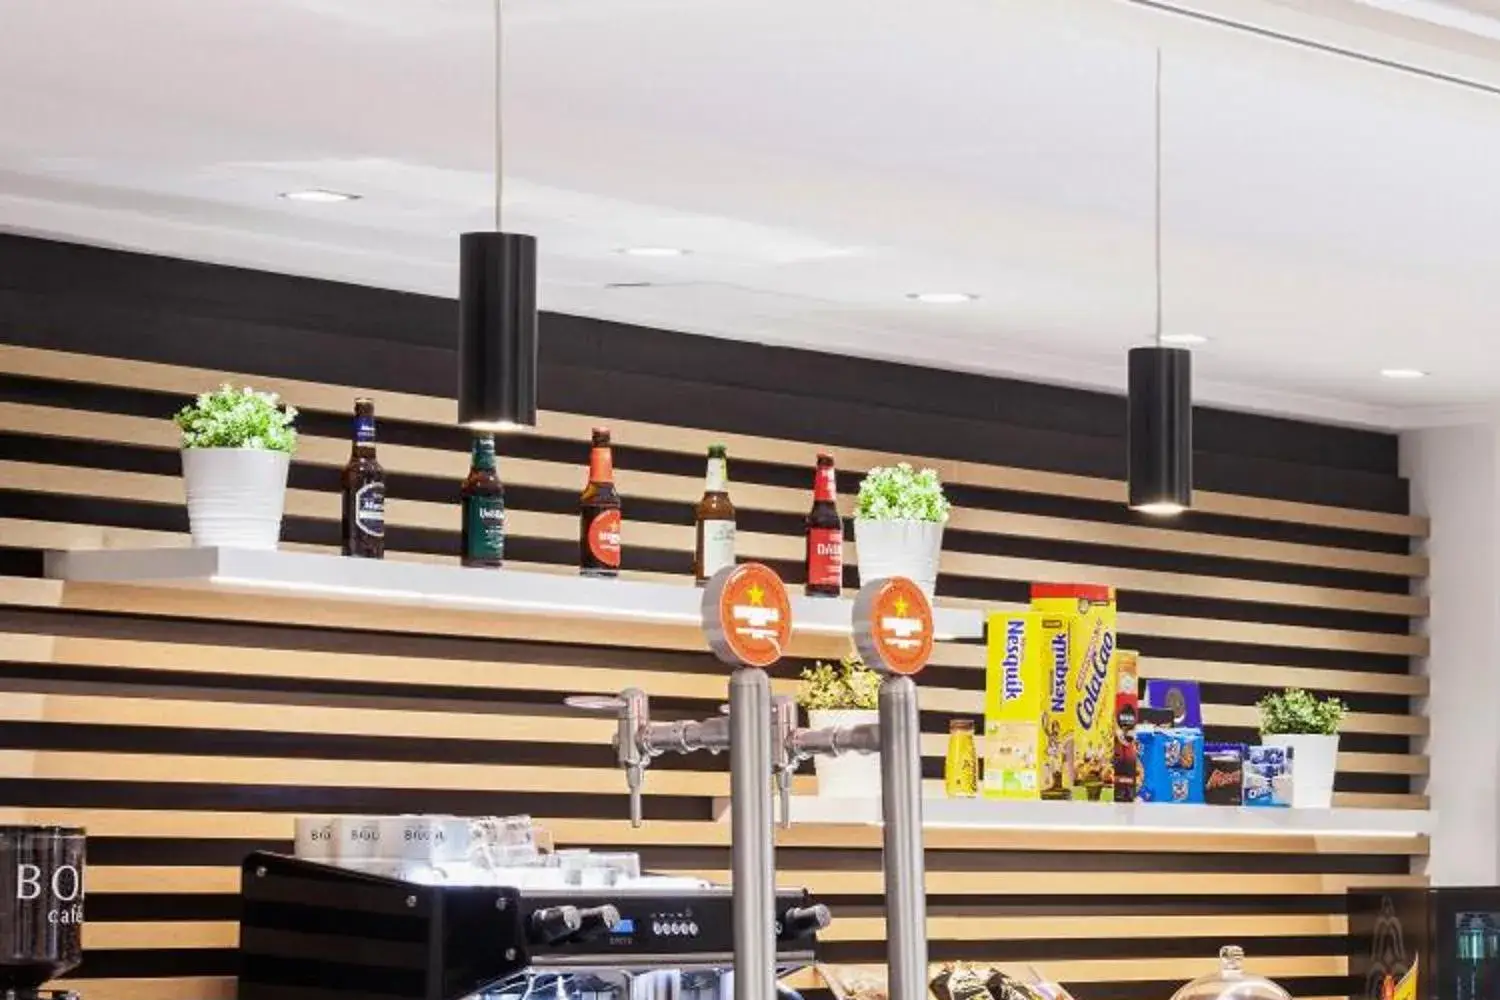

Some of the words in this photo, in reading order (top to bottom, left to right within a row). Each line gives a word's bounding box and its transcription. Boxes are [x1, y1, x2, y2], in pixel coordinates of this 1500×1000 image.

[1002, 620, 1024, 699] Nesquik
[1050, 633, 1068, 713] Nesquik
[1076, 631, 1113, 730] ColaCao
[16, 863, 85, 901] BO
